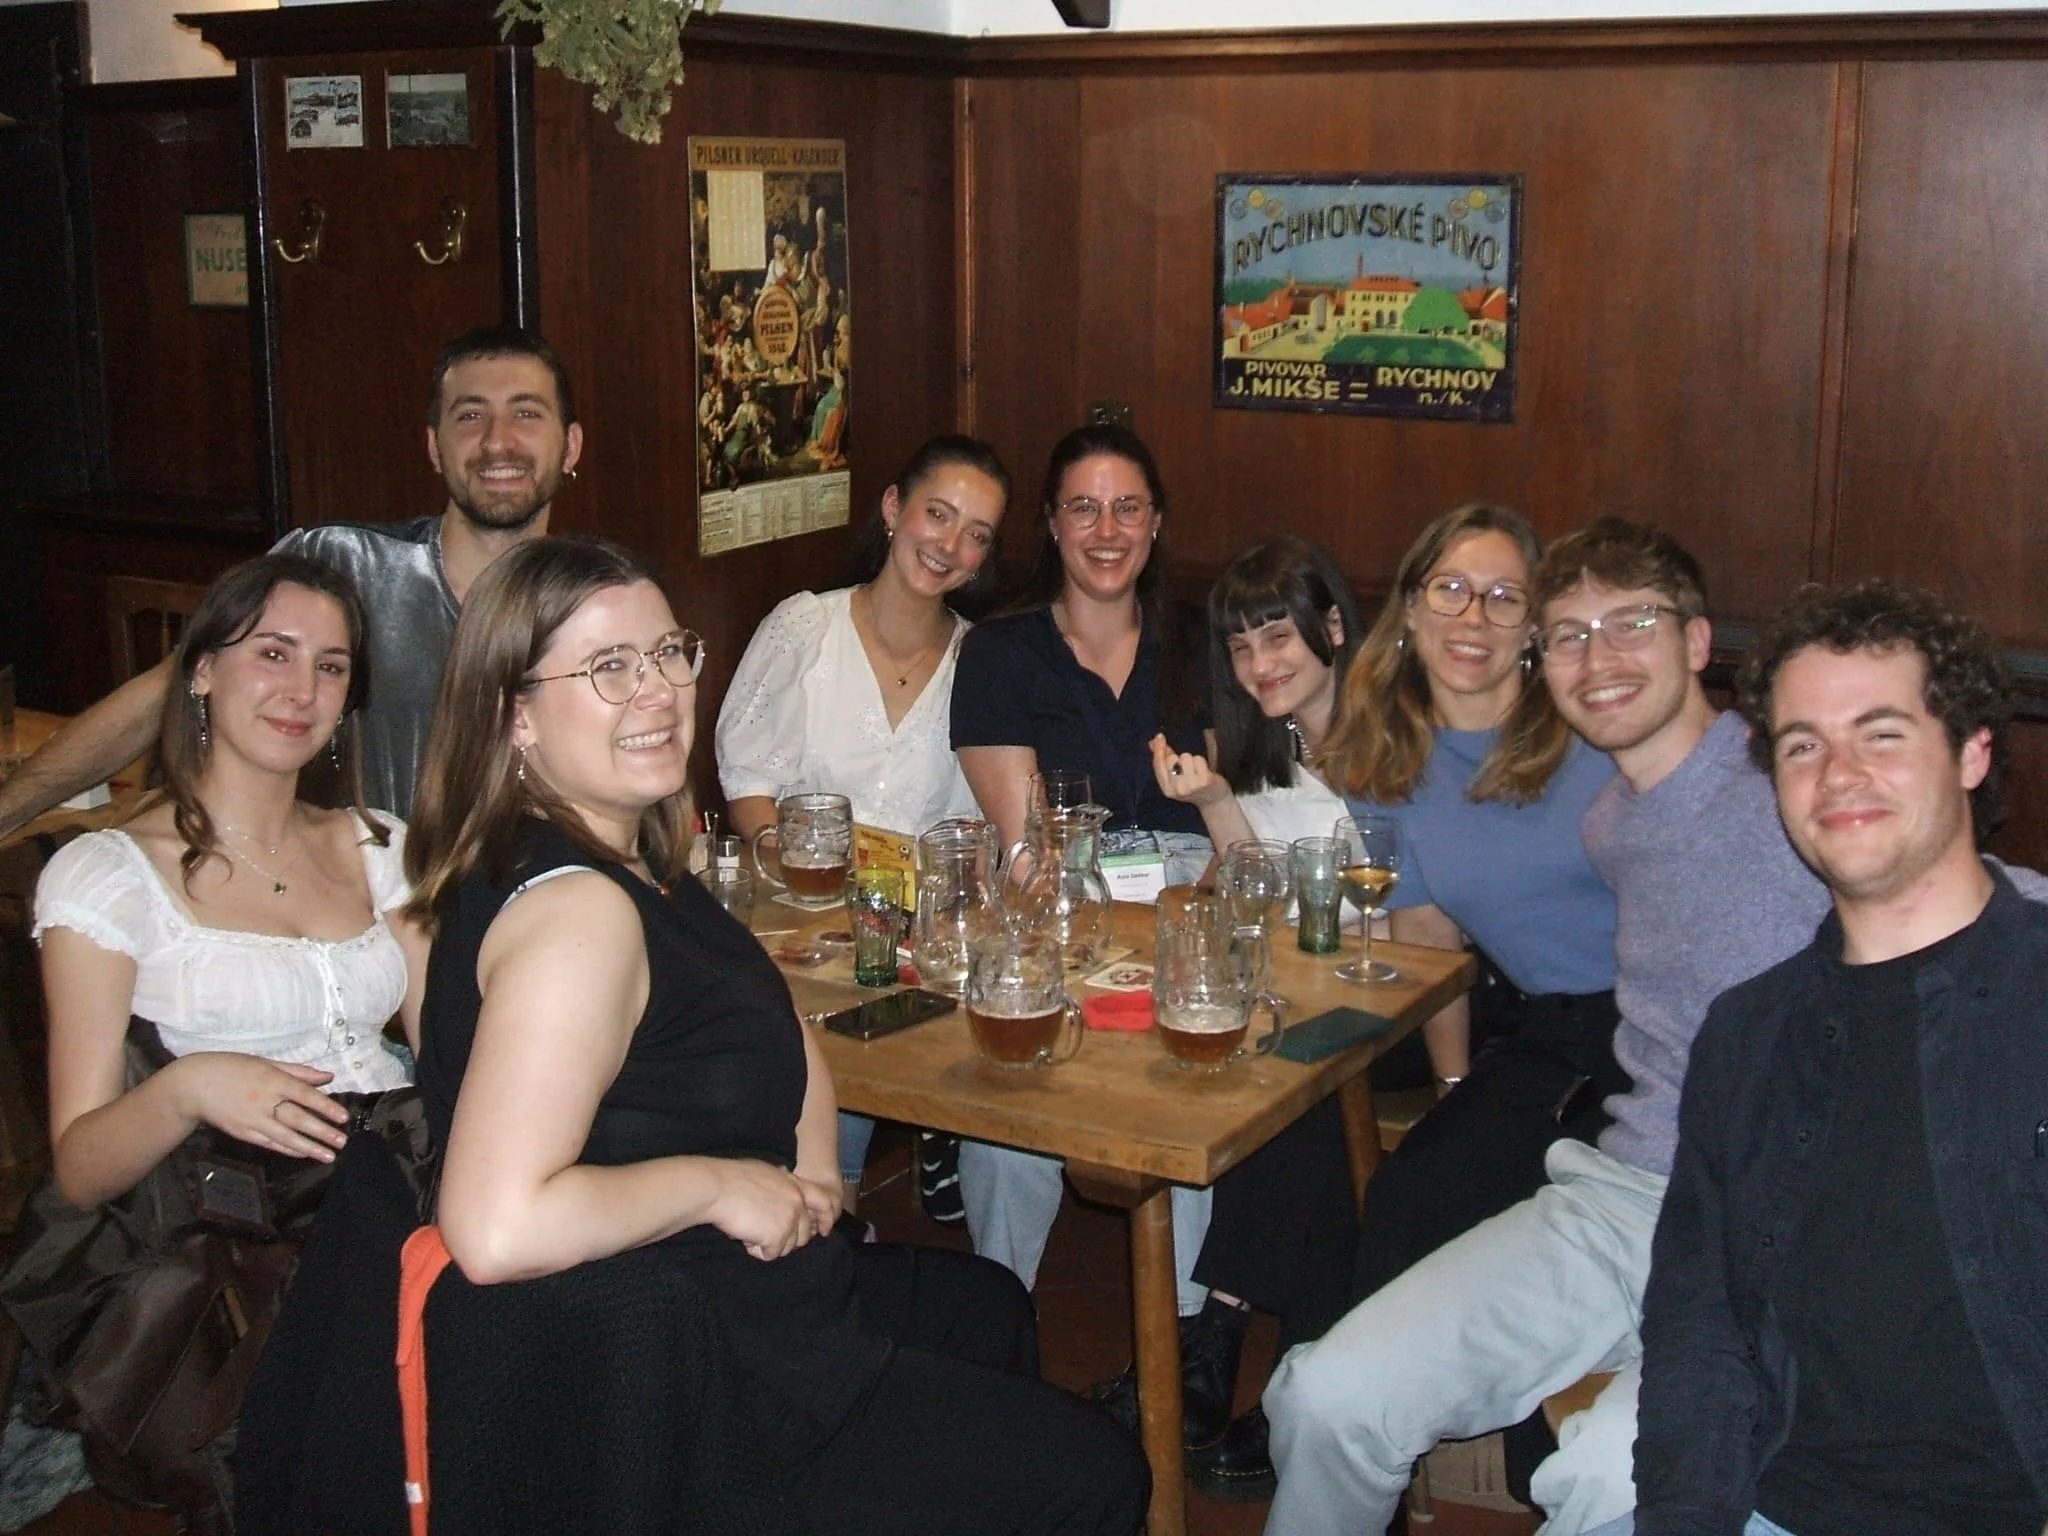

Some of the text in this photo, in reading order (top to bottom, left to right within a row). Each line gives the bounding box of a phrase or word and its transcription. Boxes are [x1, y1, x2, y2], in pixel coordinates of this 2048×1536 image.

[696, 145, 742, 165] PILSNER
[1232, 203, 1501, 276] RYCHNOVSKÉ PIVO
[760, 322, 794, 336] PILSEN
[1245, 361, 1327, 378] PIVOVAR
[1376, 367, 1497, 390] RYCHNOV
